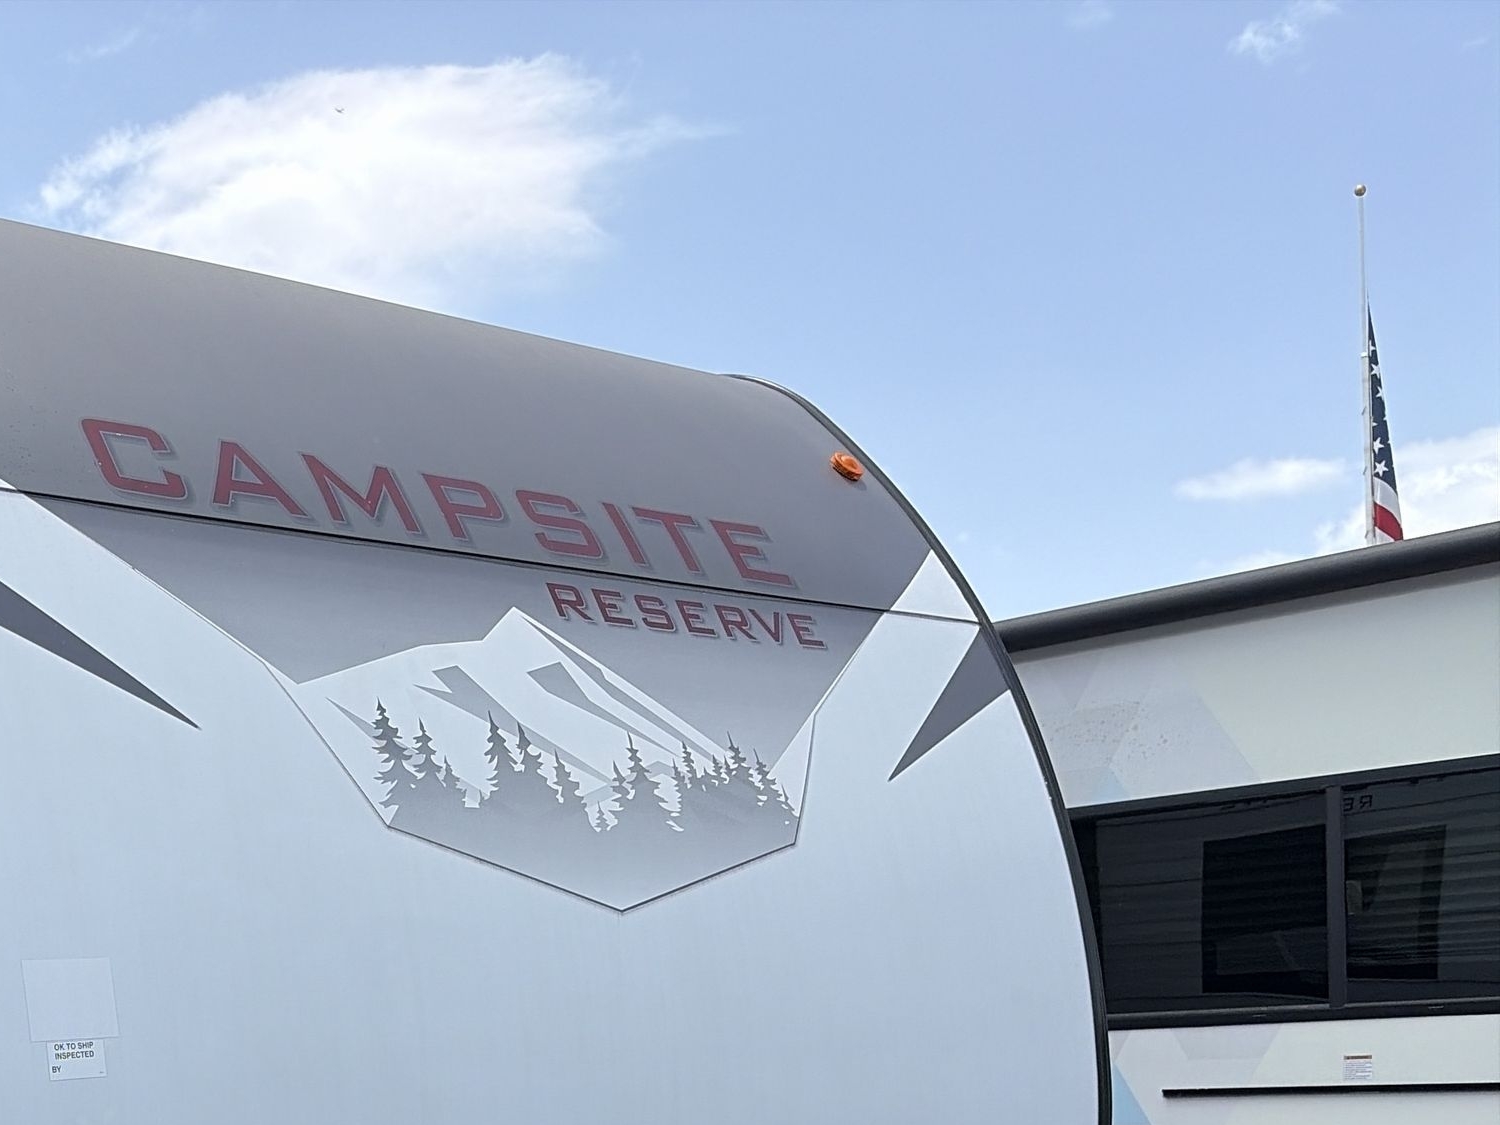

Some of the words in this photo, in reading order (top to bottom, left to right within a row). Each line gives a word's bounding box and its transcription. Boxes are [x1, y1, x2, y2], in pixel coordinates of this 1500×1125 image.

[80, 417, 797, 586] CAMPSITE
[545, 581, 826, 650] RESERVE
[55, 1051, 94, 1060] INSPECTED
[66, 1042, 77, 1050] TO
